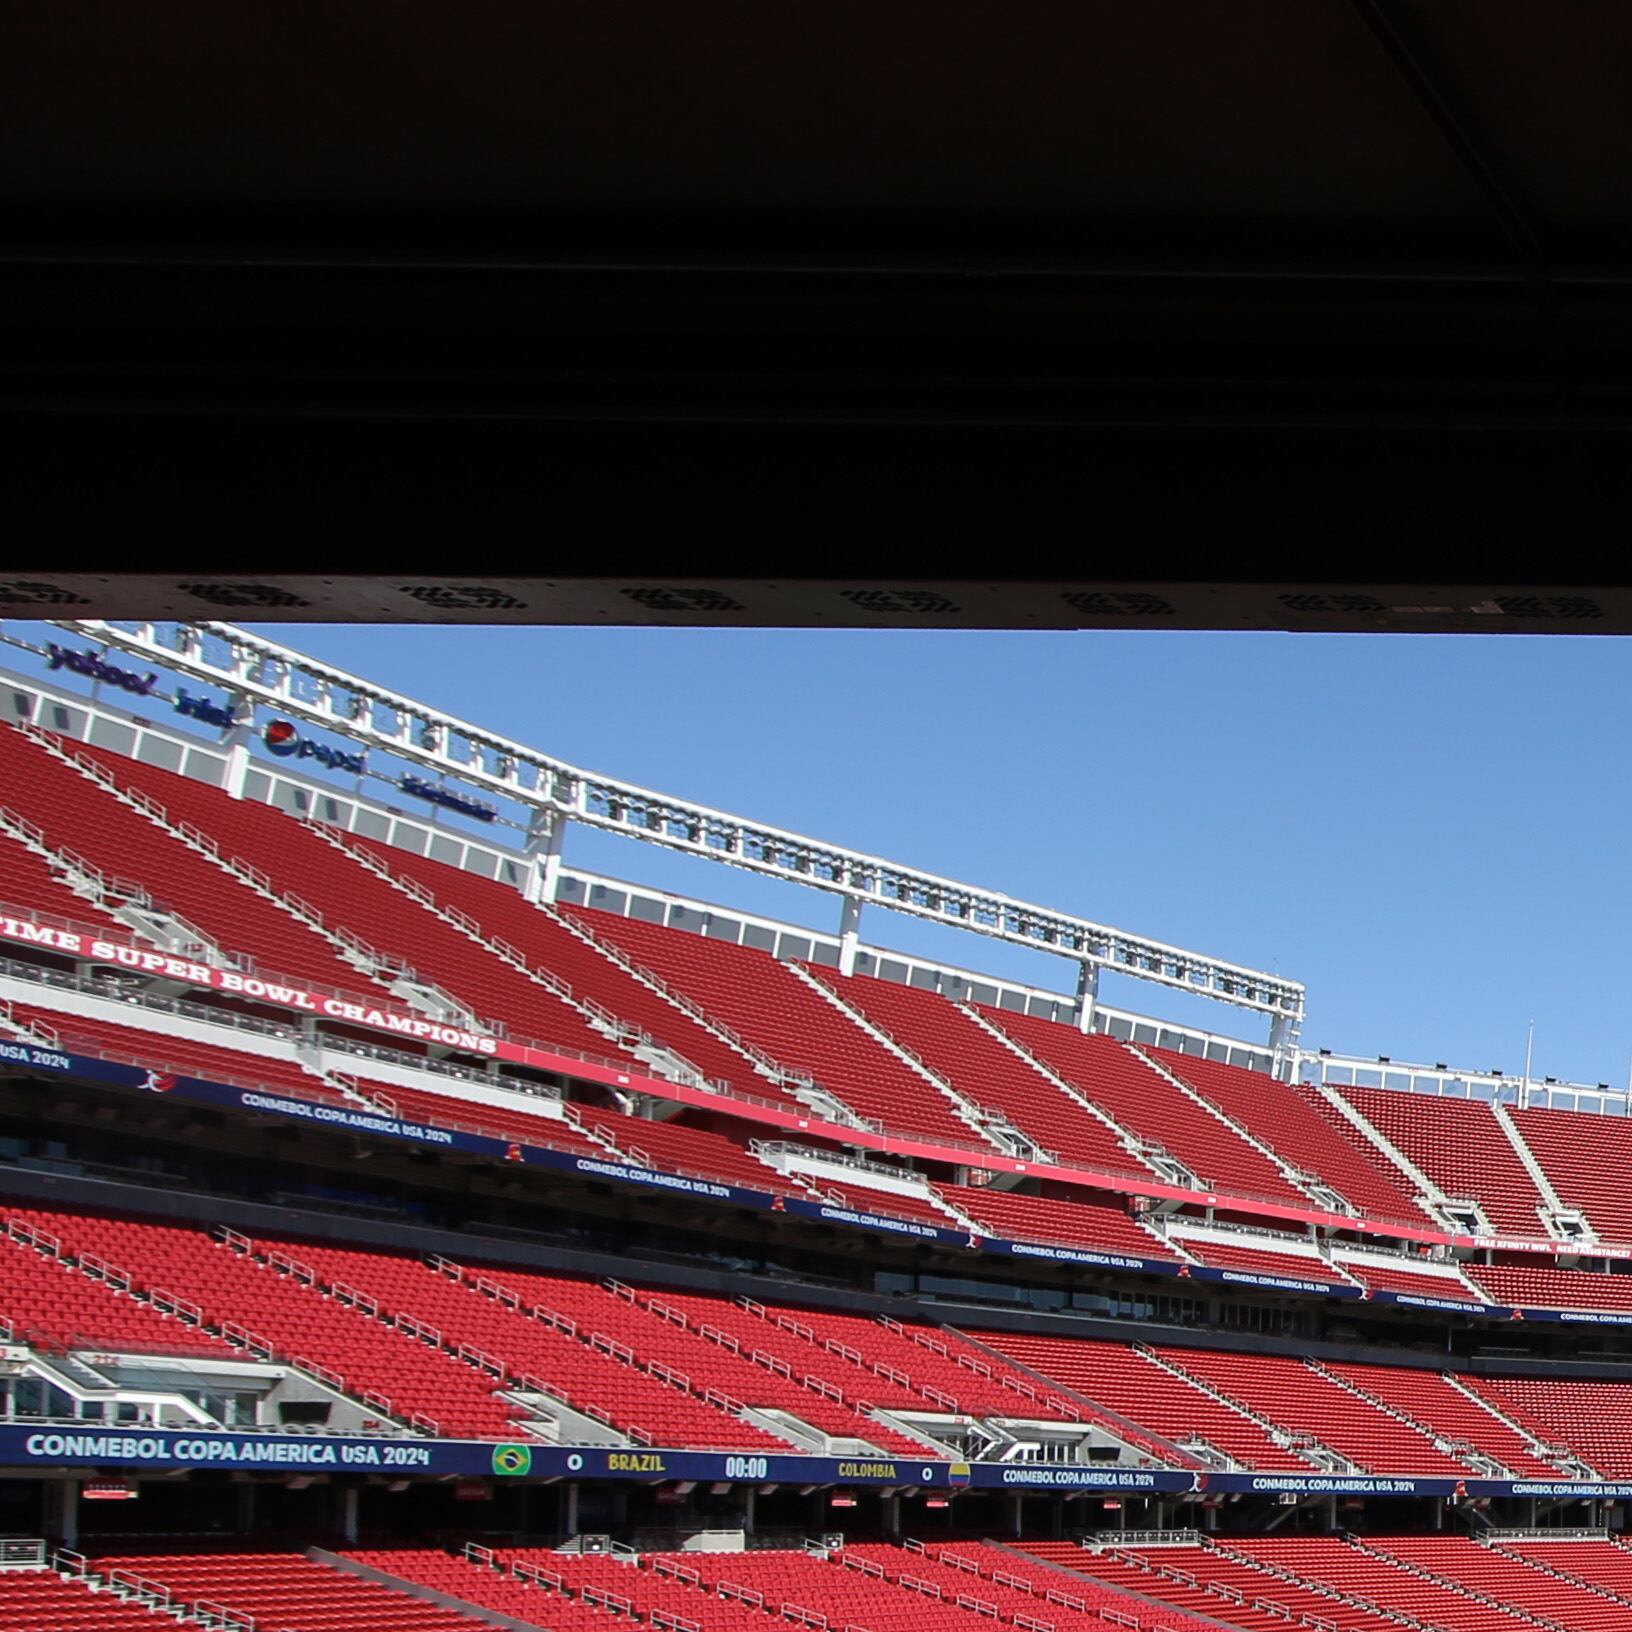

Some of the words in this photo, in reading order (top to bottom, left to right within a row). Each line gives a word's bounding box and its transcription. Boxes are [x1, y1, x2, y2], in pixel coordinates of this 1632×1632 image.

[91, 941, 212, 984] SUPER
[220, 972, 315, 1010] BOWL
[323, 999, 498, 1054] CHAMPIONS
[0, 1044, 30, 1061] USA
[32, 1049, 70, 1069] 2024
[242, 1092, 314, 1118] CONMEBOL
[314, 1107, 348, 1122] COPA
[349, 1113, 401, 1134] AMERICA
[402, 1124, 425, 1139] USA
[26, 1435, 172, 1459] CONMEBOL
[173, 1440, 236, 1461] COPA
[238, 1443, 338, 1464] AMERICA
[341, 1446, 380, 1466] USA
[383, 1447, 431, 1466] 2024
[567, 1453, 584, 1471] 0
[608, 1454, 667, 1472] BRAZIL
[725, 1456, 768, 1479] 00:00
[838, 1462, 897, 1479] COLOMBIA
[922, 1467, 934, 1482] 0
[1253, 1477, 1308, 1491] CONMEBOL
[1308, 1479, 1331, 1491] COPA
[1331, 1480, 1375, 1492] AMERICA
[1376, 1481, 1393, 1493] USA
[1394, 1481, 1415, 1493] 2024
